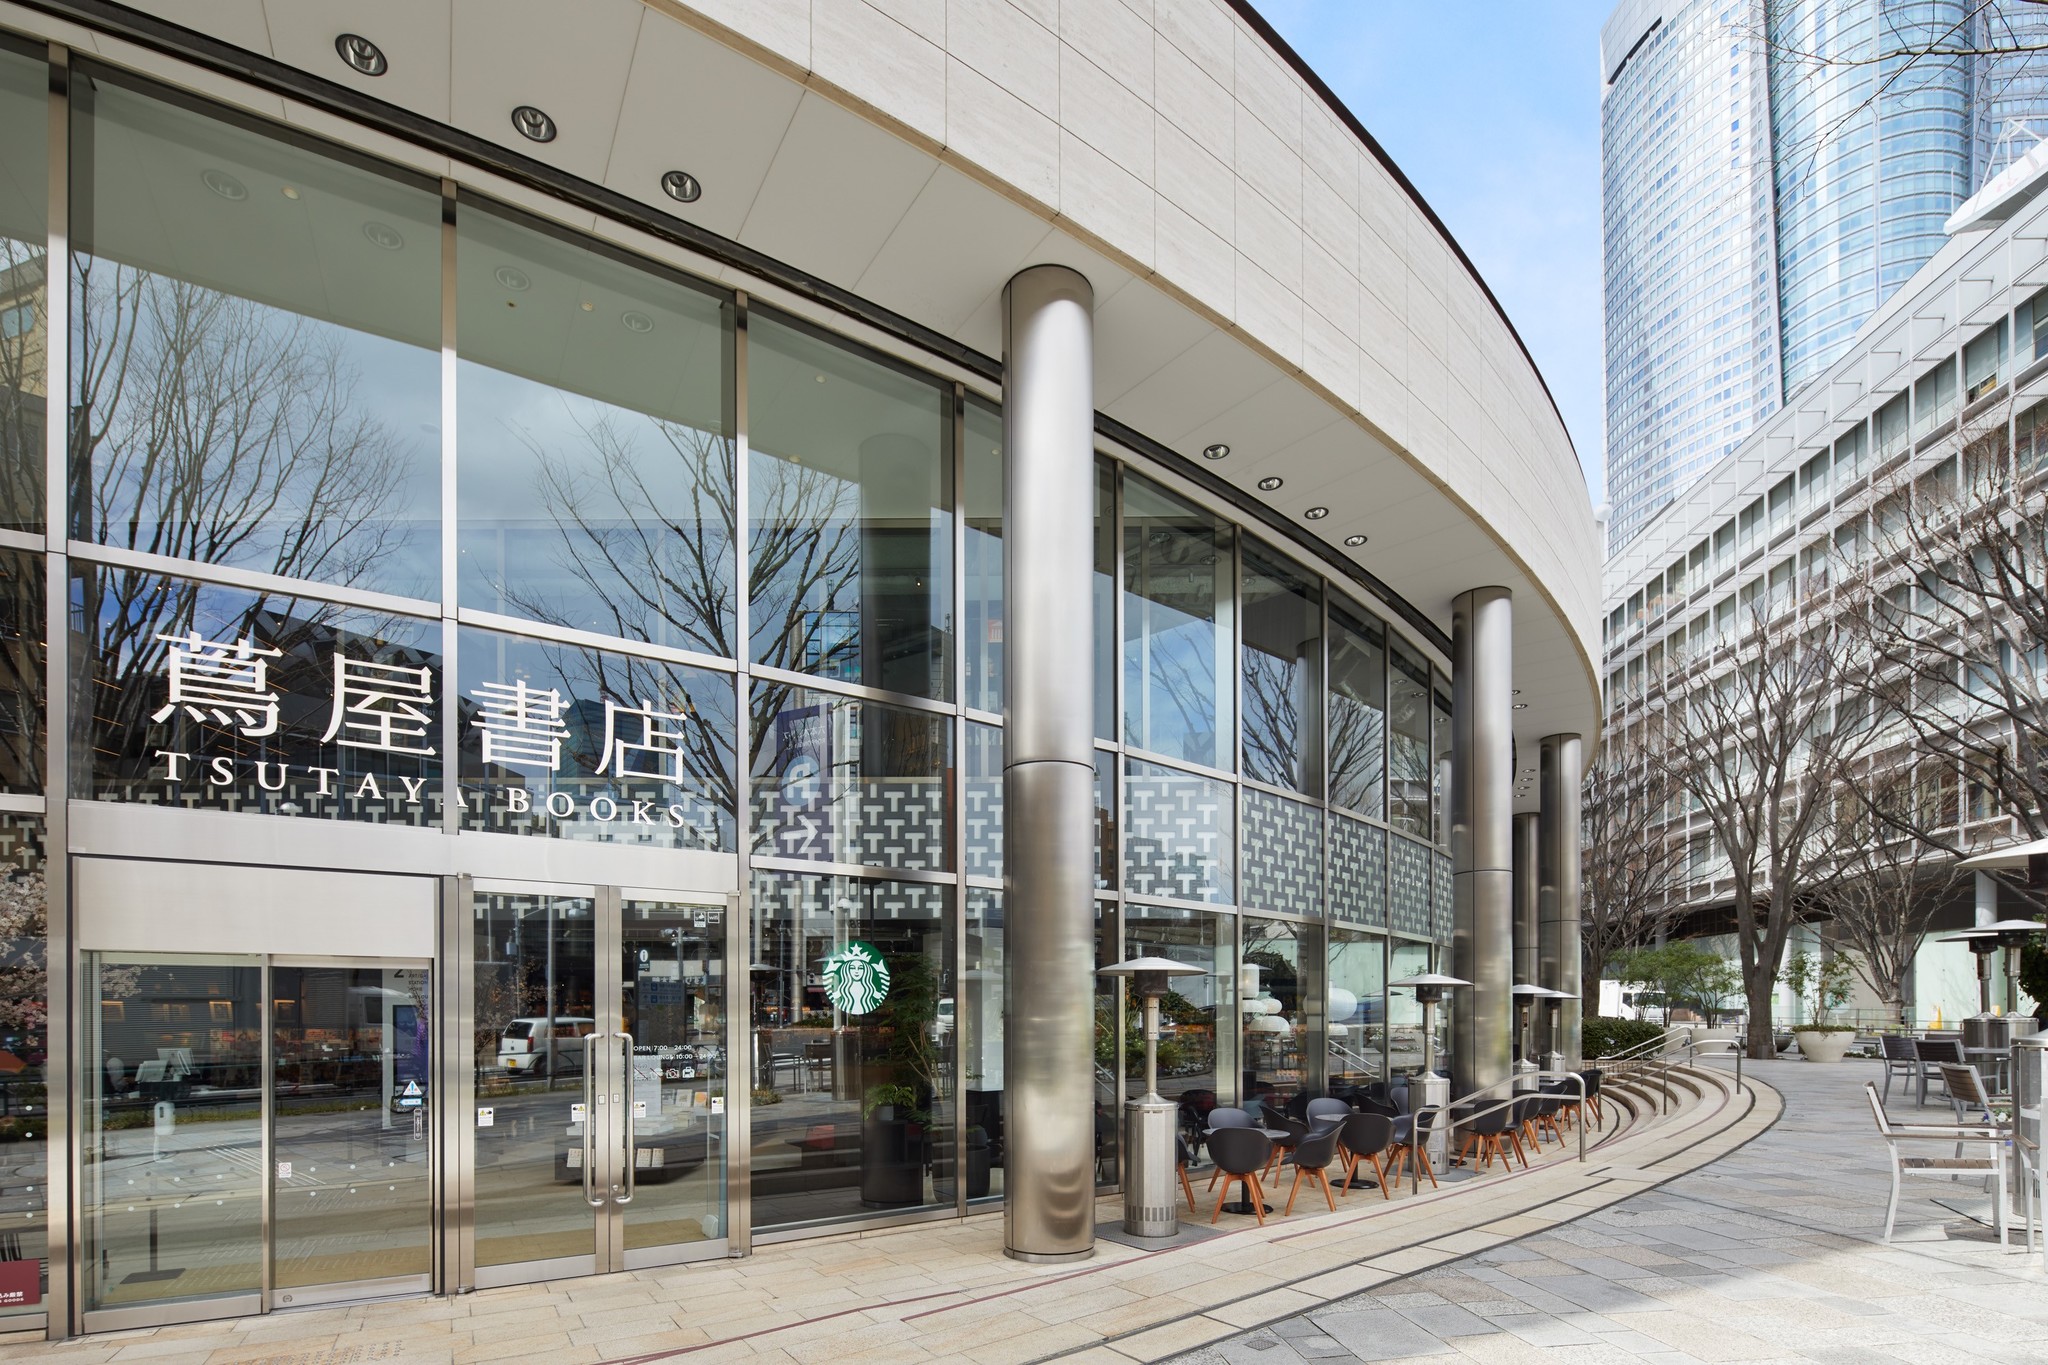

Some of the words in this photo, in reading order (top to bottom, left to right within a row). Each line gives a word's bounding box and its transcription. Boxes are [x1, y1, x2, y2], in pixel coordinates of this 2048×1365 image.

[150, 630, 688, 785] 蔦屋書店
[506, 786, 684, 828] BOOKS
